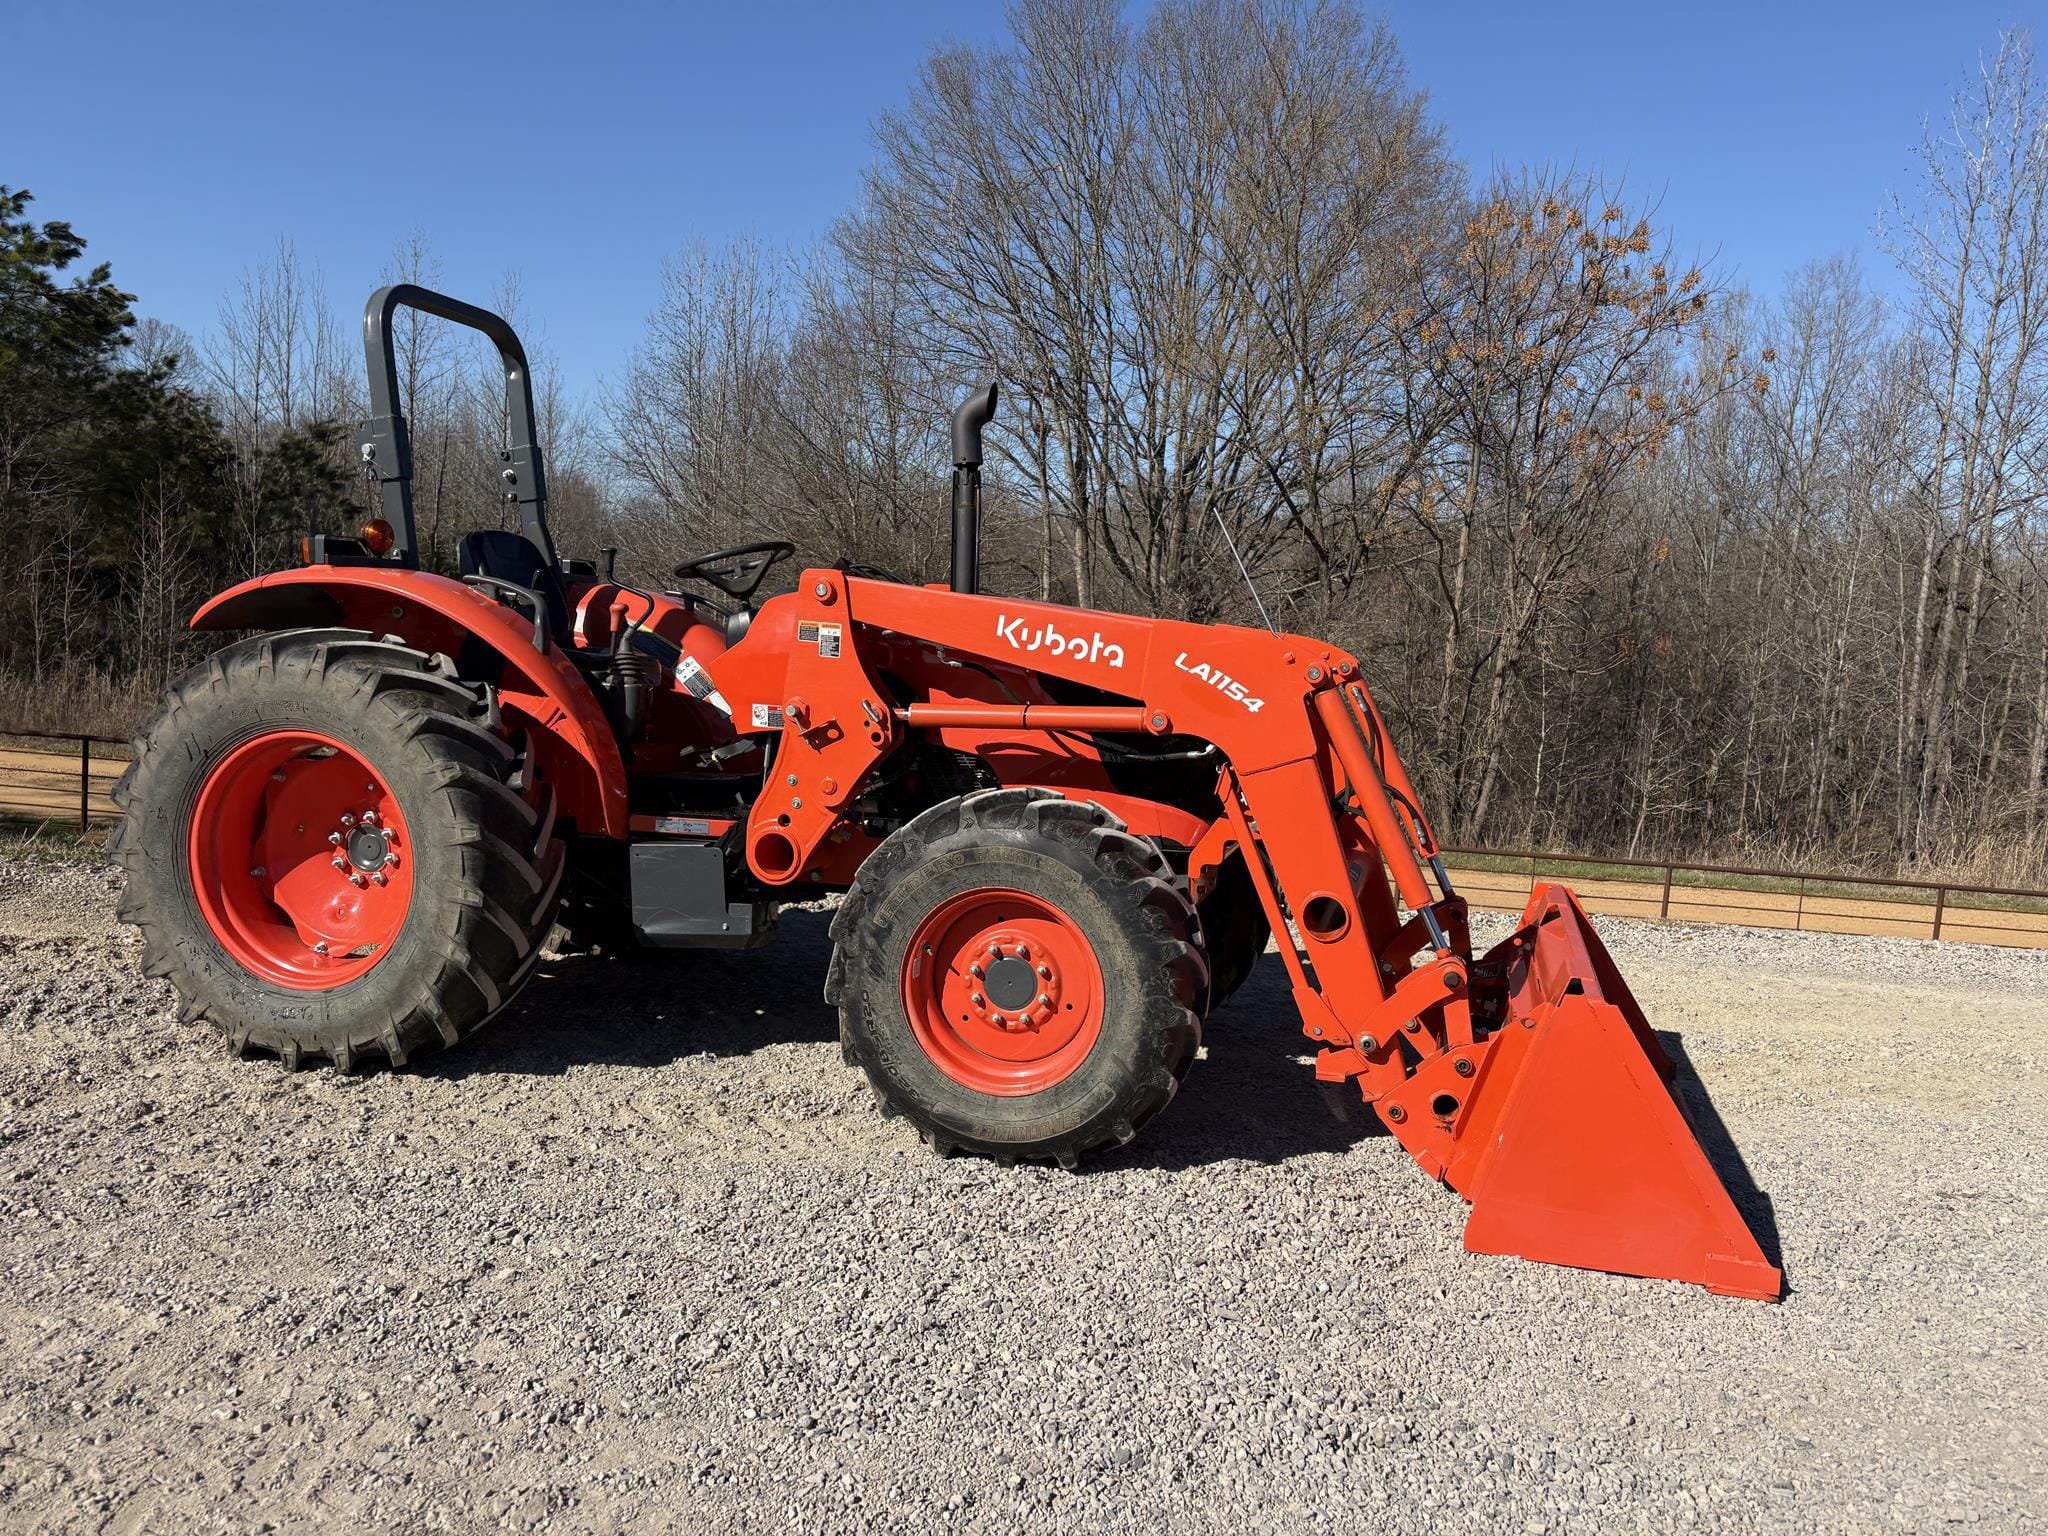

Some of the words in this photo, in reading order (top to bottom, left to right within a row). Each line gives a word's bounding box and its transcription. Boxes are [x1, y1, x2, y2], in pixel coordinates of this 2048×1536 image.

[996, 614, 1124, 667] Kubota
[1174, 652, 1264, 713] LA1154
[973, 1114, 1066, 1141] ALLIANCE
